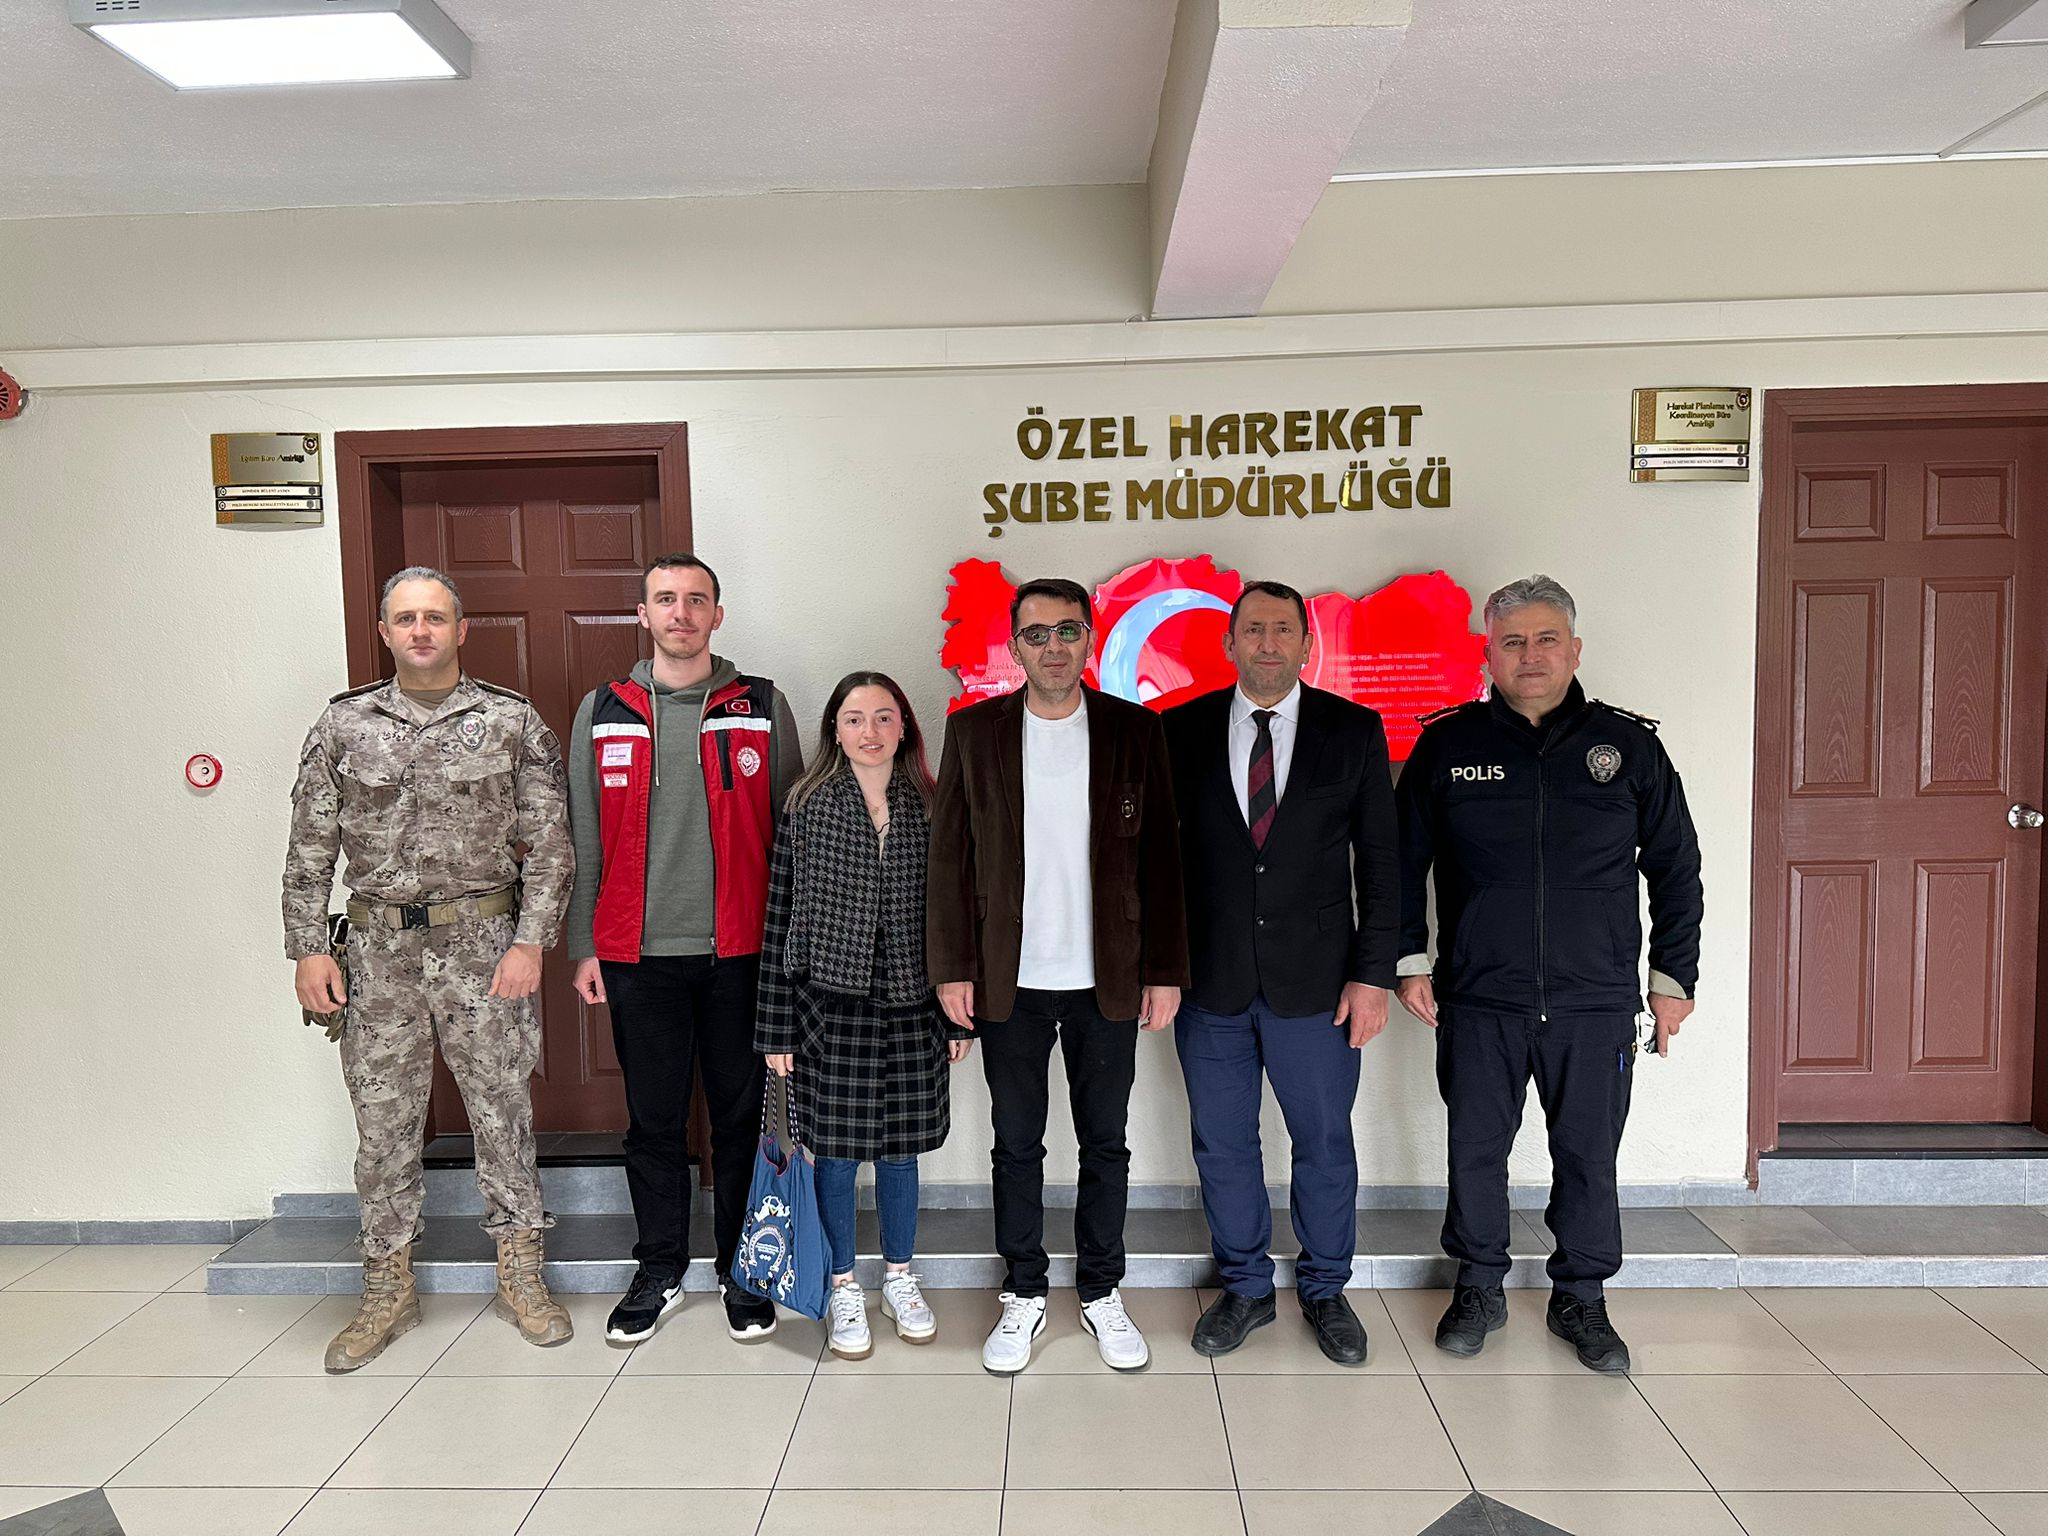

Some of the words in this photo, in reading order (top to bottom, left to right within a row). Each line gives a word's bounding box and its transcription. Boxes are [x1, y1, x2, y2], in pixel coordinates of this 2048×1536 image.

[1666, 402, 1695, 410] Harekat
[1695, 402, 1725, 410] Planlama
[1669, 411, 1716, 420] Koordinasyon
[1016, 406, 1148, 461] ÖZEL
[1169, 405, 1423, 462] HAREKAT
[983, 481, 1112, 538] ŞUBE
[1126, 456, 1451, 521] MÜDÜRLÜĞÜ
